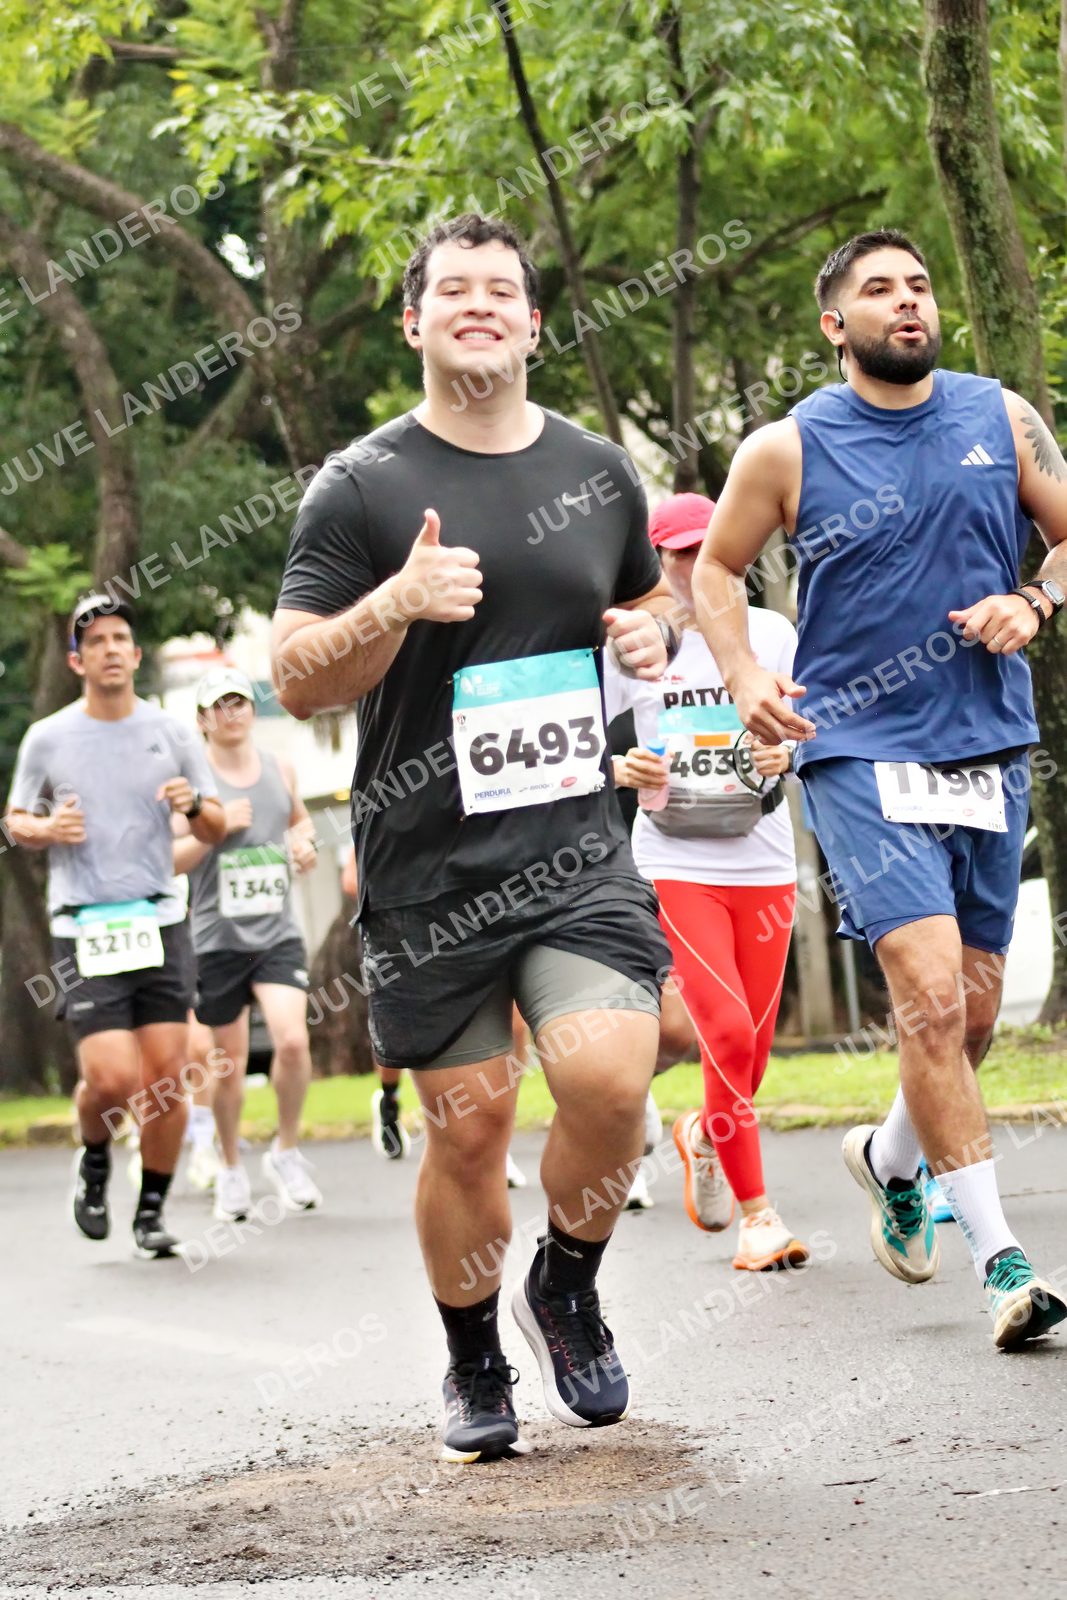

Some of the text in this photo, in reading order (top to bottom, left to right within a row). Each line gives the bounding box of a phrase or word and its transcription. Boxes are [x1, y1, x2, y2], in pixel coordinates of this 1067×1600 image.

[469, 716, 601, 776] 6493
[670, 748, 754, 778] 4639
[888, 763, 996, 800] 1190
[229, 878, 285, 899] 1349
[86, 931, 152, 957] 3210
